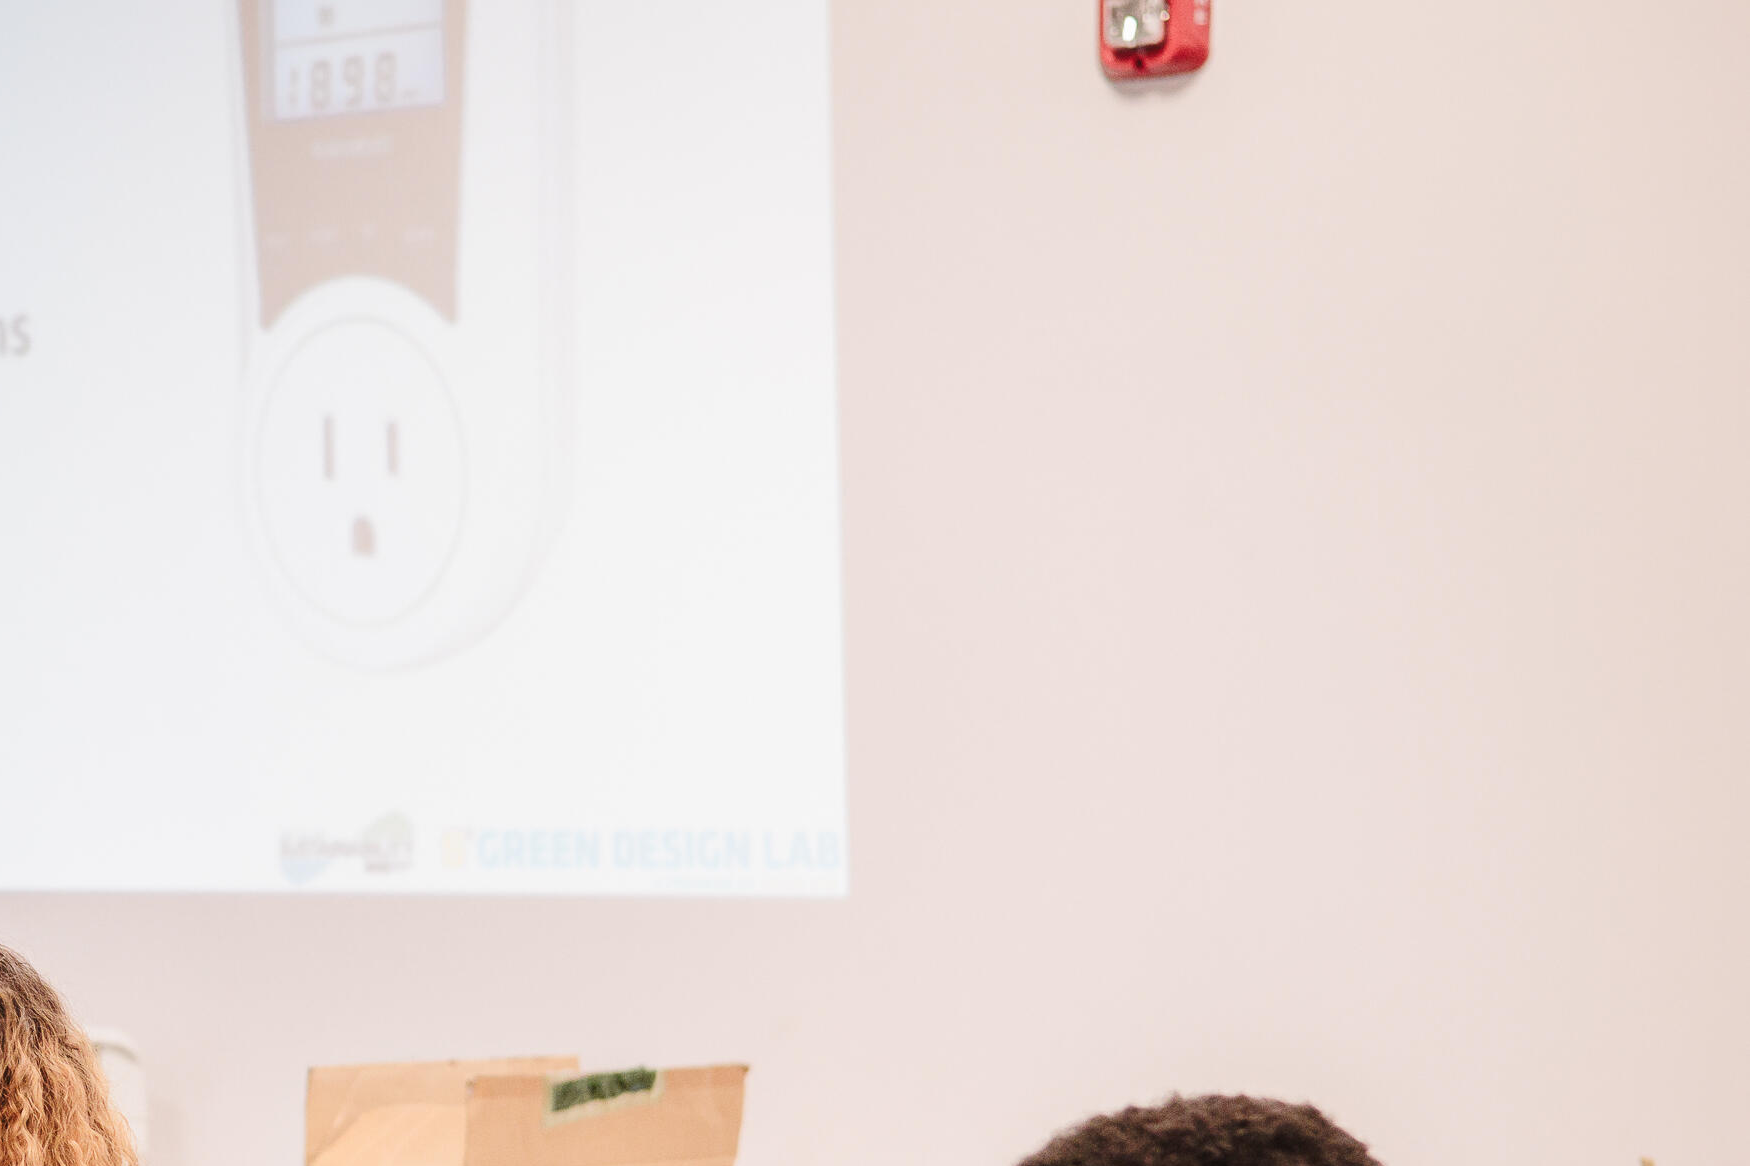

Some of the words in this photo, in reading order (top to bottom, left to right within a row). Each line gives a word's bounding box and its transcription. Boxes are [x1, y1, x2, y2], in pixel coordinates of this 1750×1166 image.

[478, 829, 601, 869] GREEN
[612, 829, 750, 869] DESIGN
[763, 829, 840, 869] LAB
